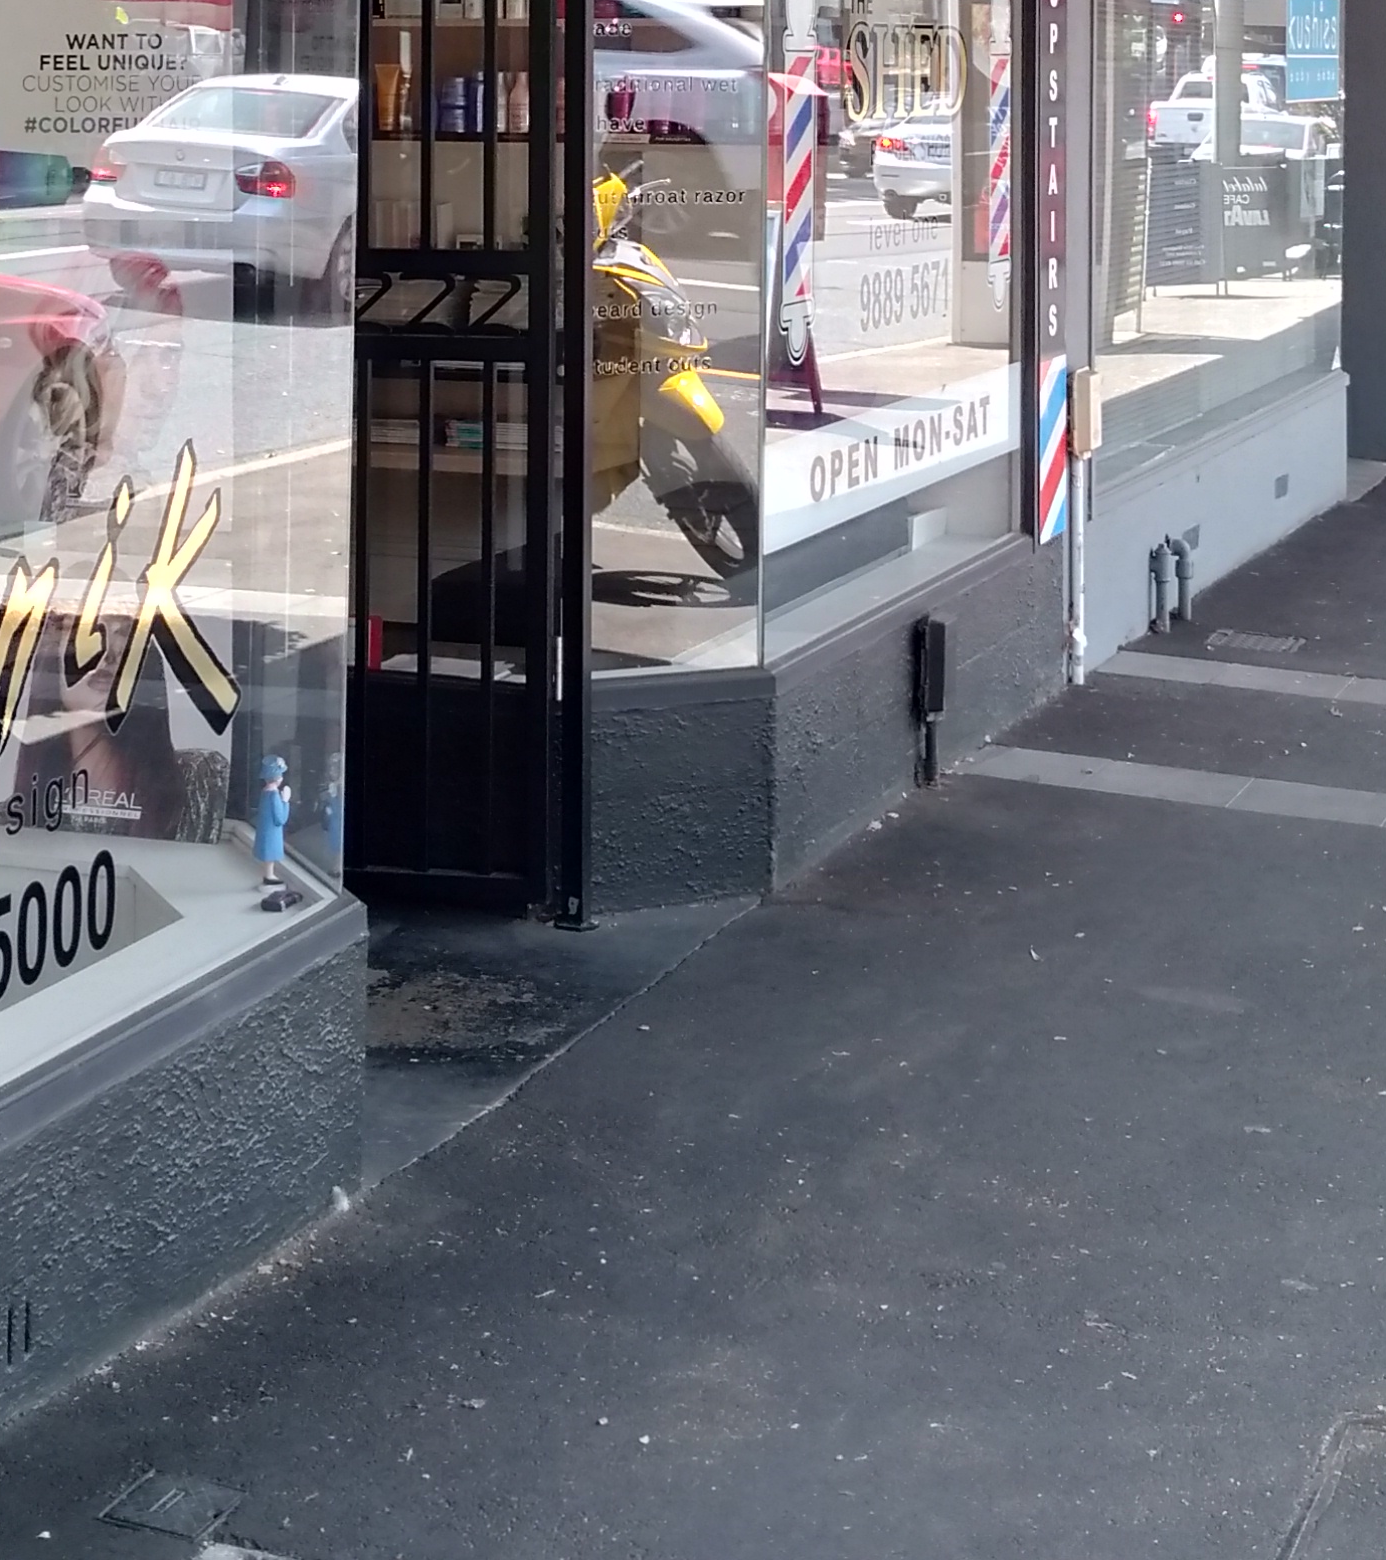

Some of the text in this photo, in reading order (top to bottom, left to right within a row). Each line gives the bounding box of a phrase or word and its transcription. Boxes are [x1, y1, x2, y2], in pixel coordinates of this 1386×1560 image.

[66, 33, 163, 50] WANT TO
[40, 54, 188, 72] FEEL UNIQUE?
[844, 21, 967, 122] SHED
[22, 75, 139, 92] CUSTOMISE
[594, 76, 738, 92] raditional wet
[54, 96, 112, 113] LOOK
[596, 115, 645, 132] have
[694, 190, 746, 205] razor
[869, 216, 939, 251] level one
[860, 257, 949, 333] 9889 5671
[593, 298, 642, 318] eard
[594, 356, 661, 375] tudent
[809, 395, 993, 503] OPEN MON-SAT
